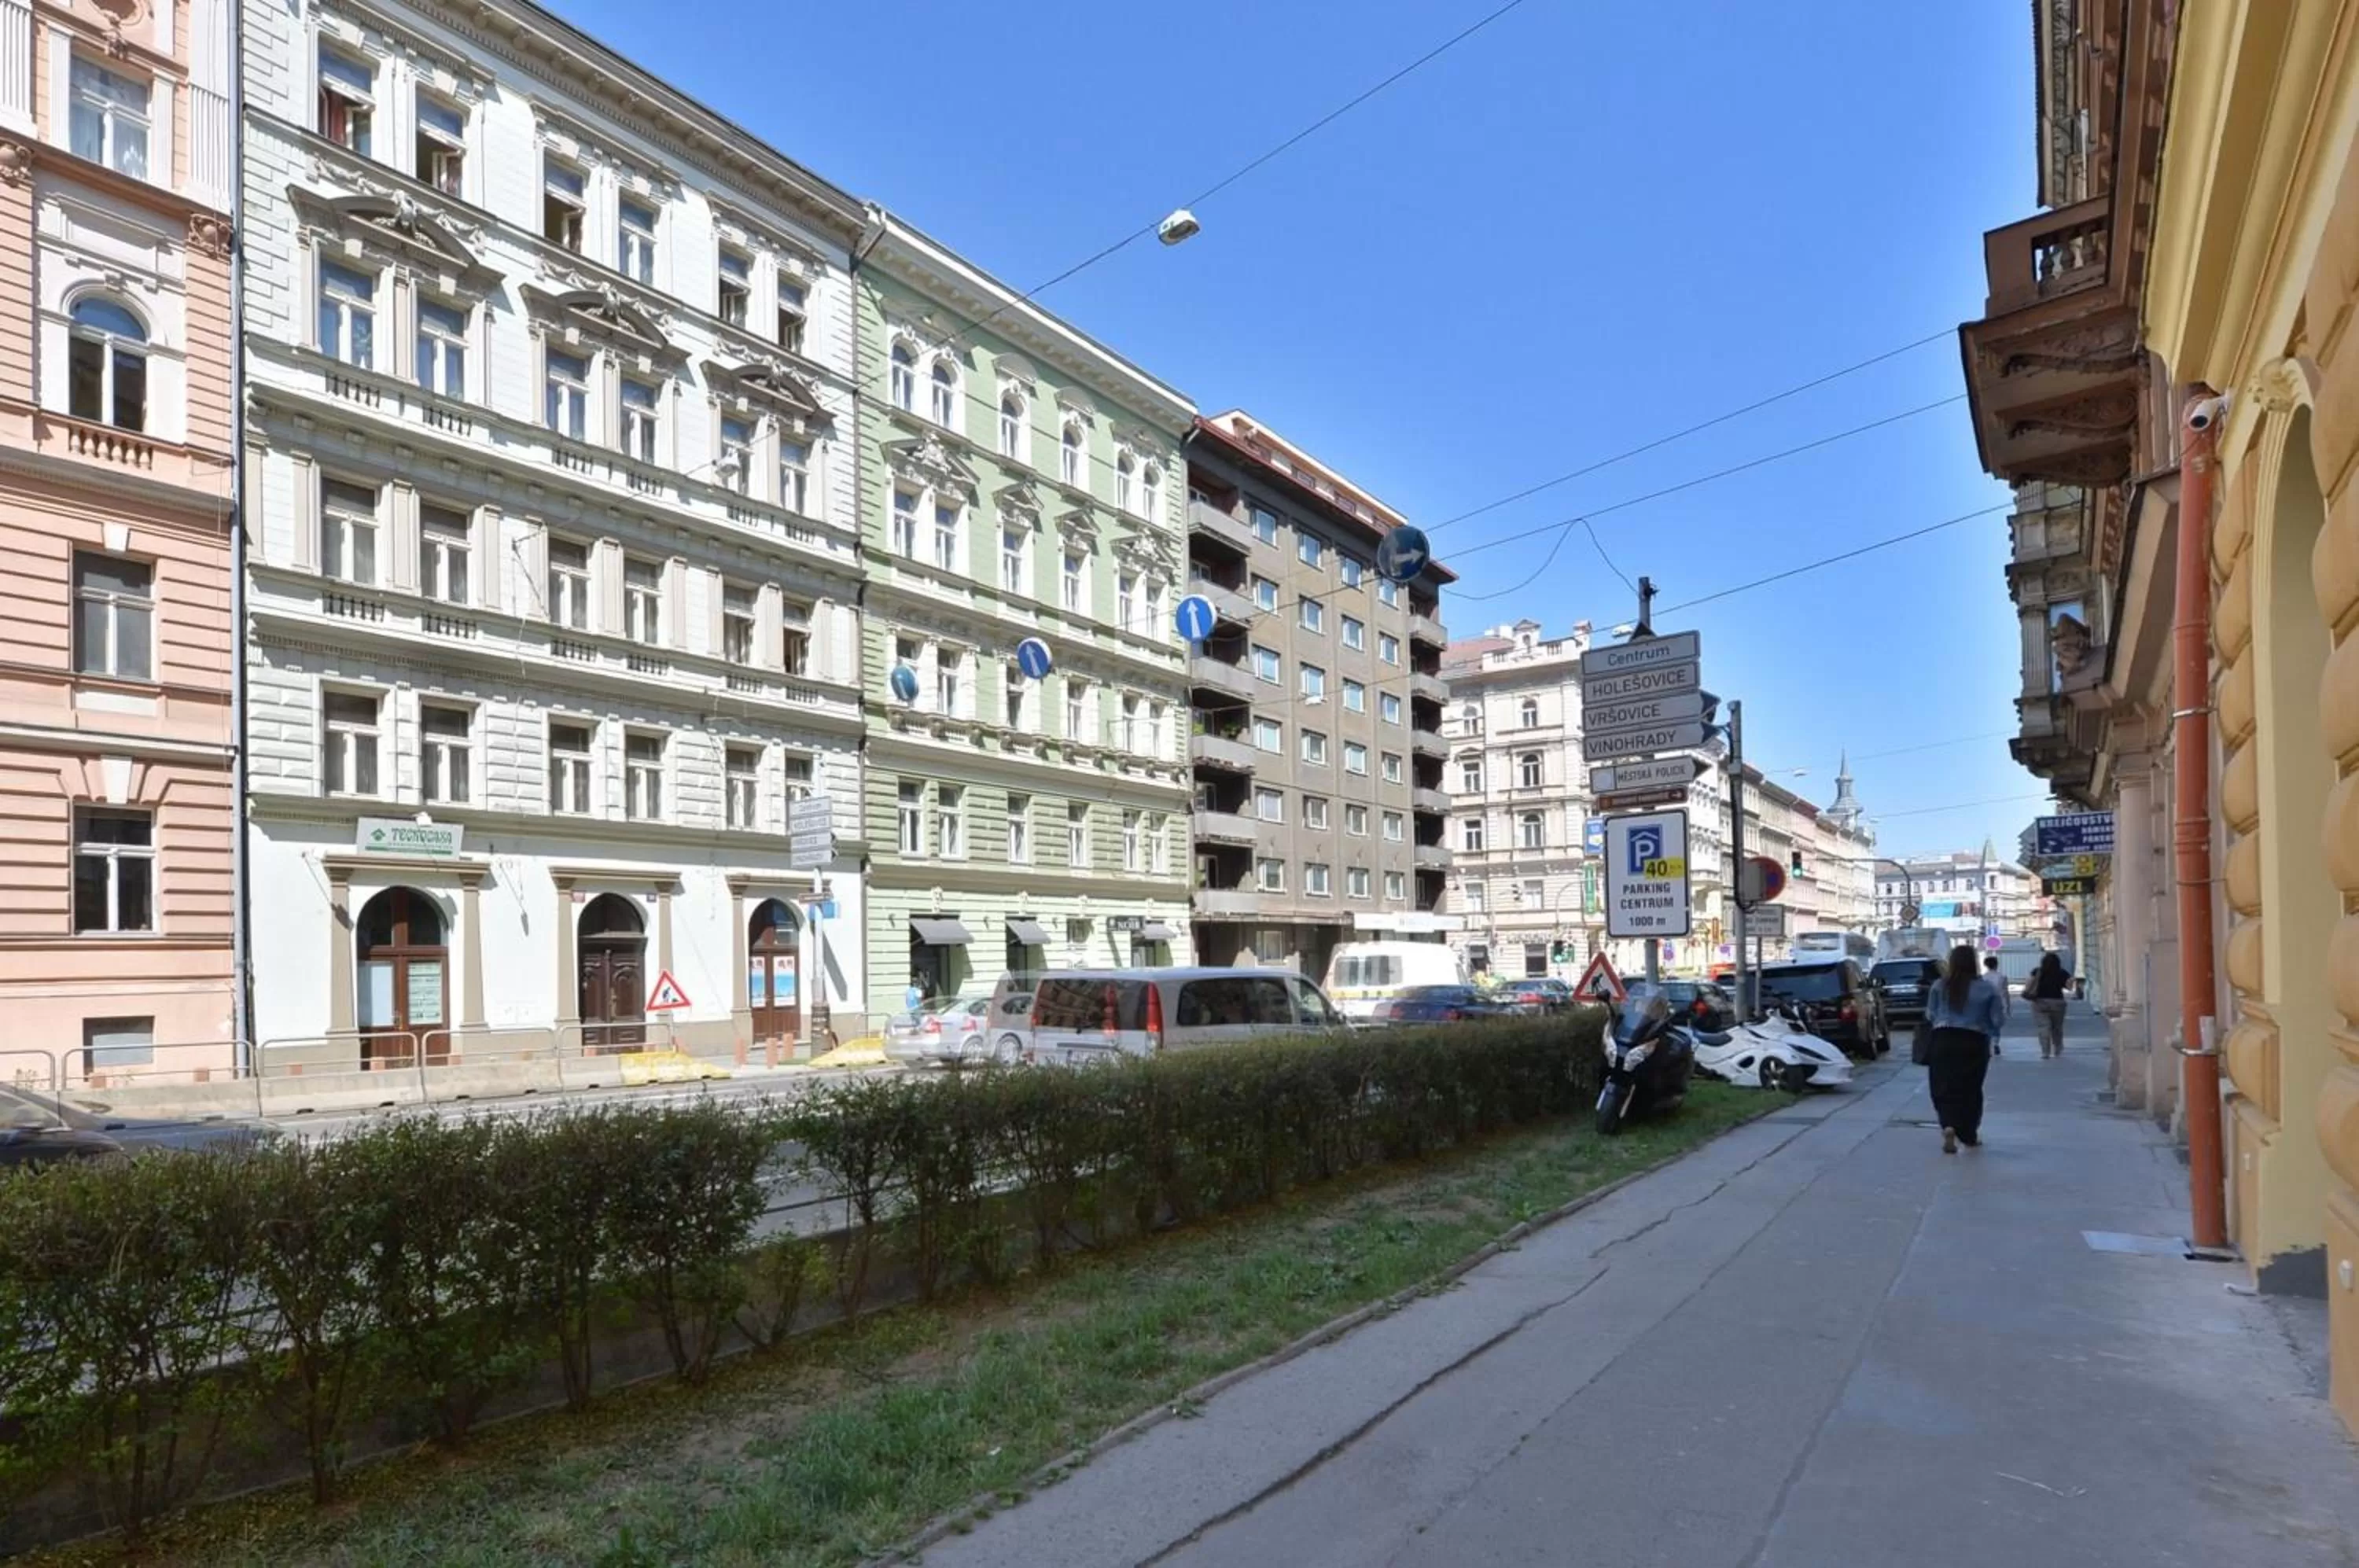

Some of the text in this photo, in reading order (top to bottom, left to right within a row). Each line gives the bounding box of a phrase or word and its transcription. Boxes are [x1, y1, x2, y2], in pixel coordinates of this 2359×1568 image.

[1608, 646, 1670, 666] Centrum
[1592, 669, 1686, 697] HOLEŠOVICE
[1587, 704, 1662, 727] VRŠOVICE
[1588, 730, 1676, 753] VINOHRADY
[1617, 765, 1686, 782] MĚSTSKÁ POLICIE
[1647, 860, 1668, 877] 40
[1622, 882, 1670, 895] PARKING
[2052, 881, 2082, 894] UZI
[1620, 897, 1673, 910] CENTRUM
[1629, 916, 1665, 926] 1000 m
